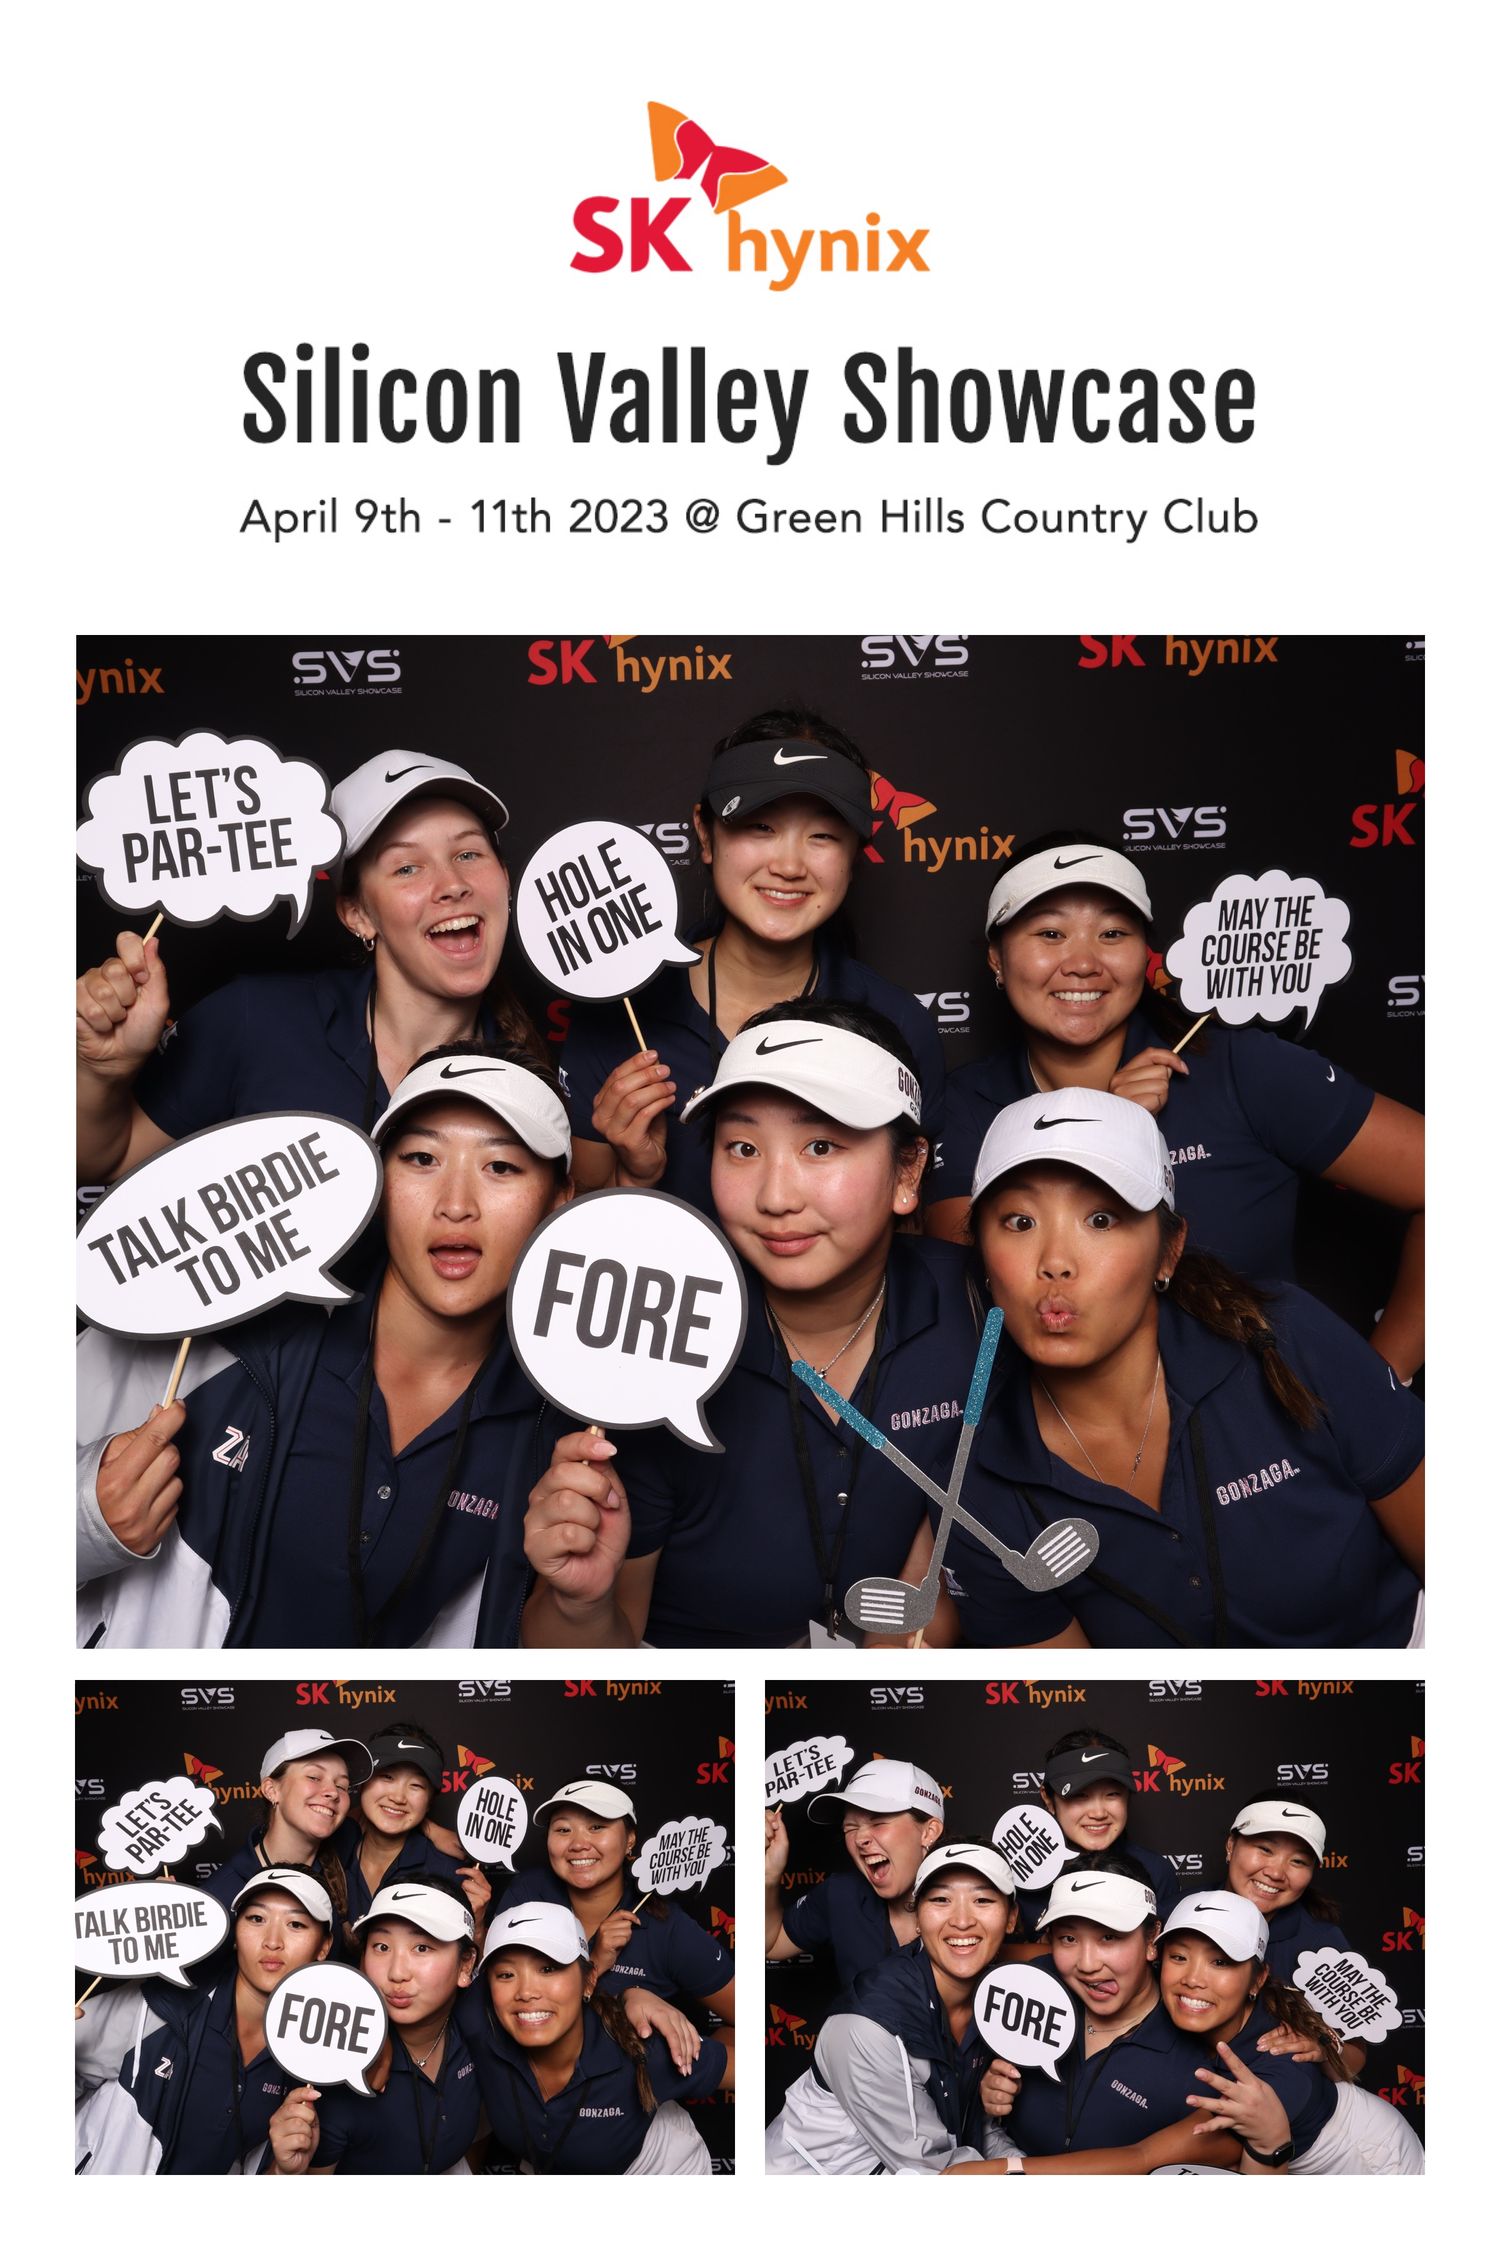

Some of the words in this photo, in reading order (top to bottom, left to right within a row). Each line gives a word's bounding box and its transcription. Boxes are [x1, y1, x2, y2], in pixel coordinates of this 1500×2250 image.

[292, 649, 401, 684] SVS
[528, 639, 597, 685] SK
[617, 645, 733, 693] hynix
[1078, 635, 1145, 669] SK
[1165, 635, 1278, 676] hynix
[294, 689, 325, 697] SILICON
[326, 688, 356, 696] VALLEY
[357, 687, 402, 695] SHOWCASE
[861, 672, 892, 680] SILICON
[893, 671, 923, 679] VALLEY
[924, 670, 969, 678] SHOWCASE
[1122, 806, 1227, 840] SVS
[1349, 802, 1417, 848] SK
[122, 817, 297, 883] PAR-TEE
[904, 826, 1015, 874] hynix
[1154, 843, 1181, 851] VALLEY
[1182, 842, 1226, 850] SHOWCASE
[534, 838, 632, 923] HOLE
[546, 919, 592, 976] IN
[587, 882, 663, 954] ONE
[1218, 897, 1267, 931] MAY
[1274, 895, 1315, 927] THE
[1201, 931, 1289, 966] COURSE
[1293, 928, 1323, 959] BE
[1206, 967, 1265, 999] WITH
[1270, 963, 1312, 994] YOU
[1169, 1143, 1205, 1165] ZAGA
[87, 1197, 207, 1285] TALK
[197, 1131, 340, 1235] BIRDIE
[174, 1244, 240, 1307] TO
[238, 1208, 311, 1280] ME
[533, 1248, 724, 1369] FORE
[890, 1400, 960, 1431] GONZAGA
[1216, 1458, 1294, 1506] GONZAGA
[447, 1489, 498, 1520] ONZAGA
[295, 1682, 330, 1706] SK
[339, 1685, 396, 1708] hynix
[564, 1680, 597, 1697] SK
[606, 1680, 662, 1700] hynix
[985, 1682, 1019, 1705] SK
[1028, 1685, 1086, 1708] hynix
[1255, 1680, 1289, 1697] SK
[1298, 1680, 1354, 1700] hynix
[696, 1762, 729, 1784] SK
[765, 1754, 837, 1798] PAR-TEE
[1170, 1773, 1224, 1797] hynix
[1388, 1762, 1421, 1784] SK
[475, 1787, 518, 1822] HOLE
[125, 1798, 203, 1864] PAR-TEE
[465, 1812, 481, 1840] IN
[484, 1817, 516, 1848] ONE
[659, 1831, 686, 1850] MAY
[688, 1826, 710, 1845] THE
[998, 1811, 1038, 1859] HOLE
[650, 1846, 695, 1870] COURSE
[697, 1841, 713, 1859] BE
[651, 1864, 680, 1885] WITH
[681, 1859, 705, 1879] YOU
[1009, 1858, 1034, 1883] IN
[1029, 1828, 1060, 1867] ONE
[75, 1907, 129, 1939] TALK
[134, 1901, 208, 1931] BIRDIE
[108, 1937, 139, 1965] TO
[145, 1932, 179, 1960] ME
[1381, 1931, 1412, 1952] SK
[1314, 1963, 1363, 2010] COURSE
[1359, 2004, 1383, 2026] BE
[1333, 1958, 1365, 1986] MAY
[1363, 1983, 1391, 2010] THE
[983, 1984, 1067, 2048] FORE
[1304, 1975, 1339, 2009] WITH
[1335, 2006, 1364, 2031] YOU
[277, 1993, 375, 2054] FORE
